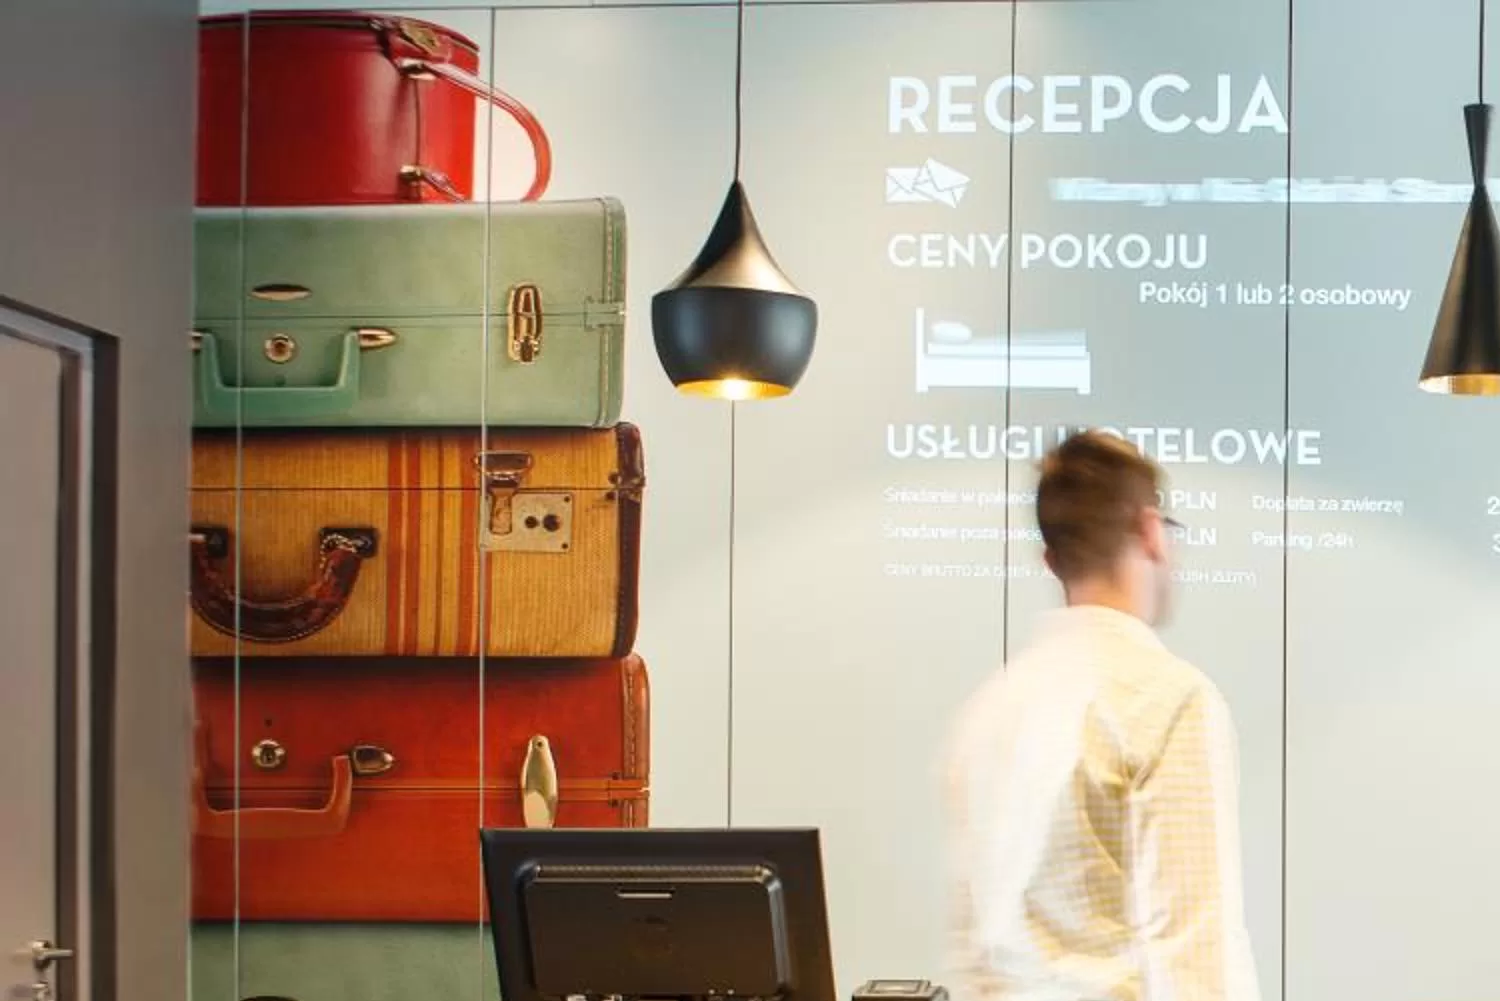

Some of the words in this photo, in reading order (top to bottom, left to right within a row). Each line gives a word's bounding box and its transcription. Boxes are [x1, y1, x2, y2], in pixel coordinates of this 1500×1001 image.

[888, 74, 1290, 135] RECEPCJA
[887, 234, 1009, 268] CENY
[1021, 234, 1208, 270] POKOJU
[1139, 281, 1208, 309] Pokój
[1216, 282, 1227, 304] 1
[1236, 281, 1273, 305] lub
[1279, 283, 1296, 306] 2
[1299, 283, 1412, 311] osobowy
[887, 423, 1043, 460] USŁUGI
[1171, 489, 1217, 510] PLN
